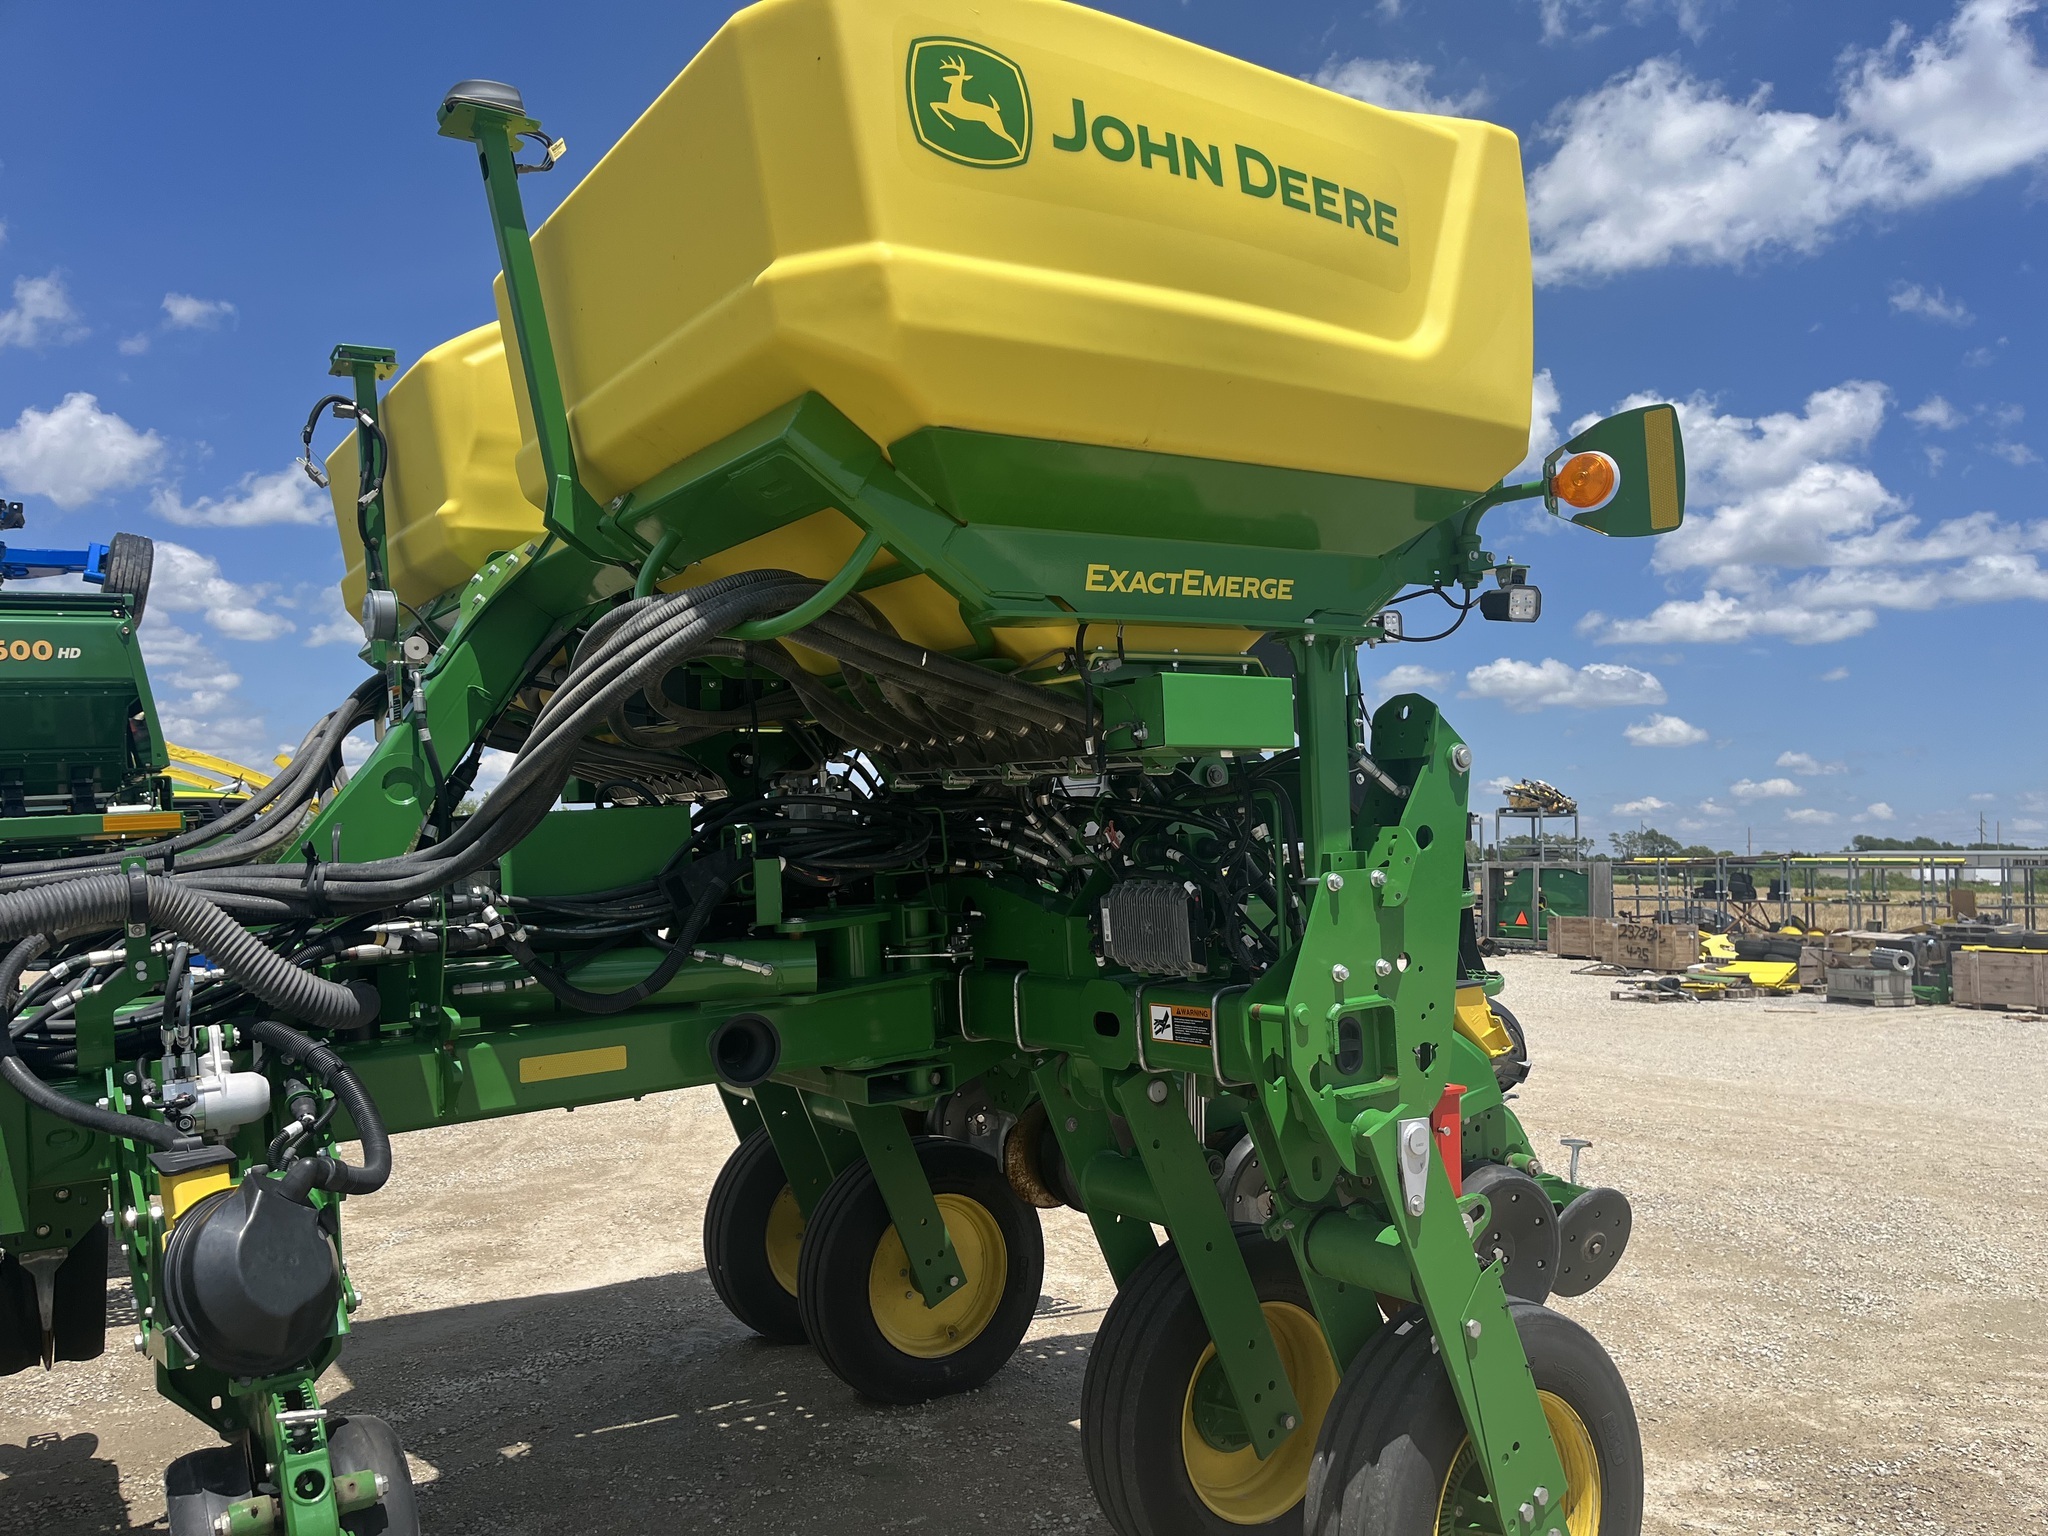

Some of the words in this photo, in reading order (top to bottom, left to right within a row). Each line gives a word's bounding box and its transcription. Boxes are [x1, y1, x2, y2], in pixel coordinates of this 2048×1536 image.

[1052, 97, 1224, 188] JOHN
[1234, 143, 1400, 247] DEERE
[1084, 563, 1295, 600] EXACTEMERGE
[57, 647, 81, 659] HD
[1181, 1008, 1208, 1017] WARNING
